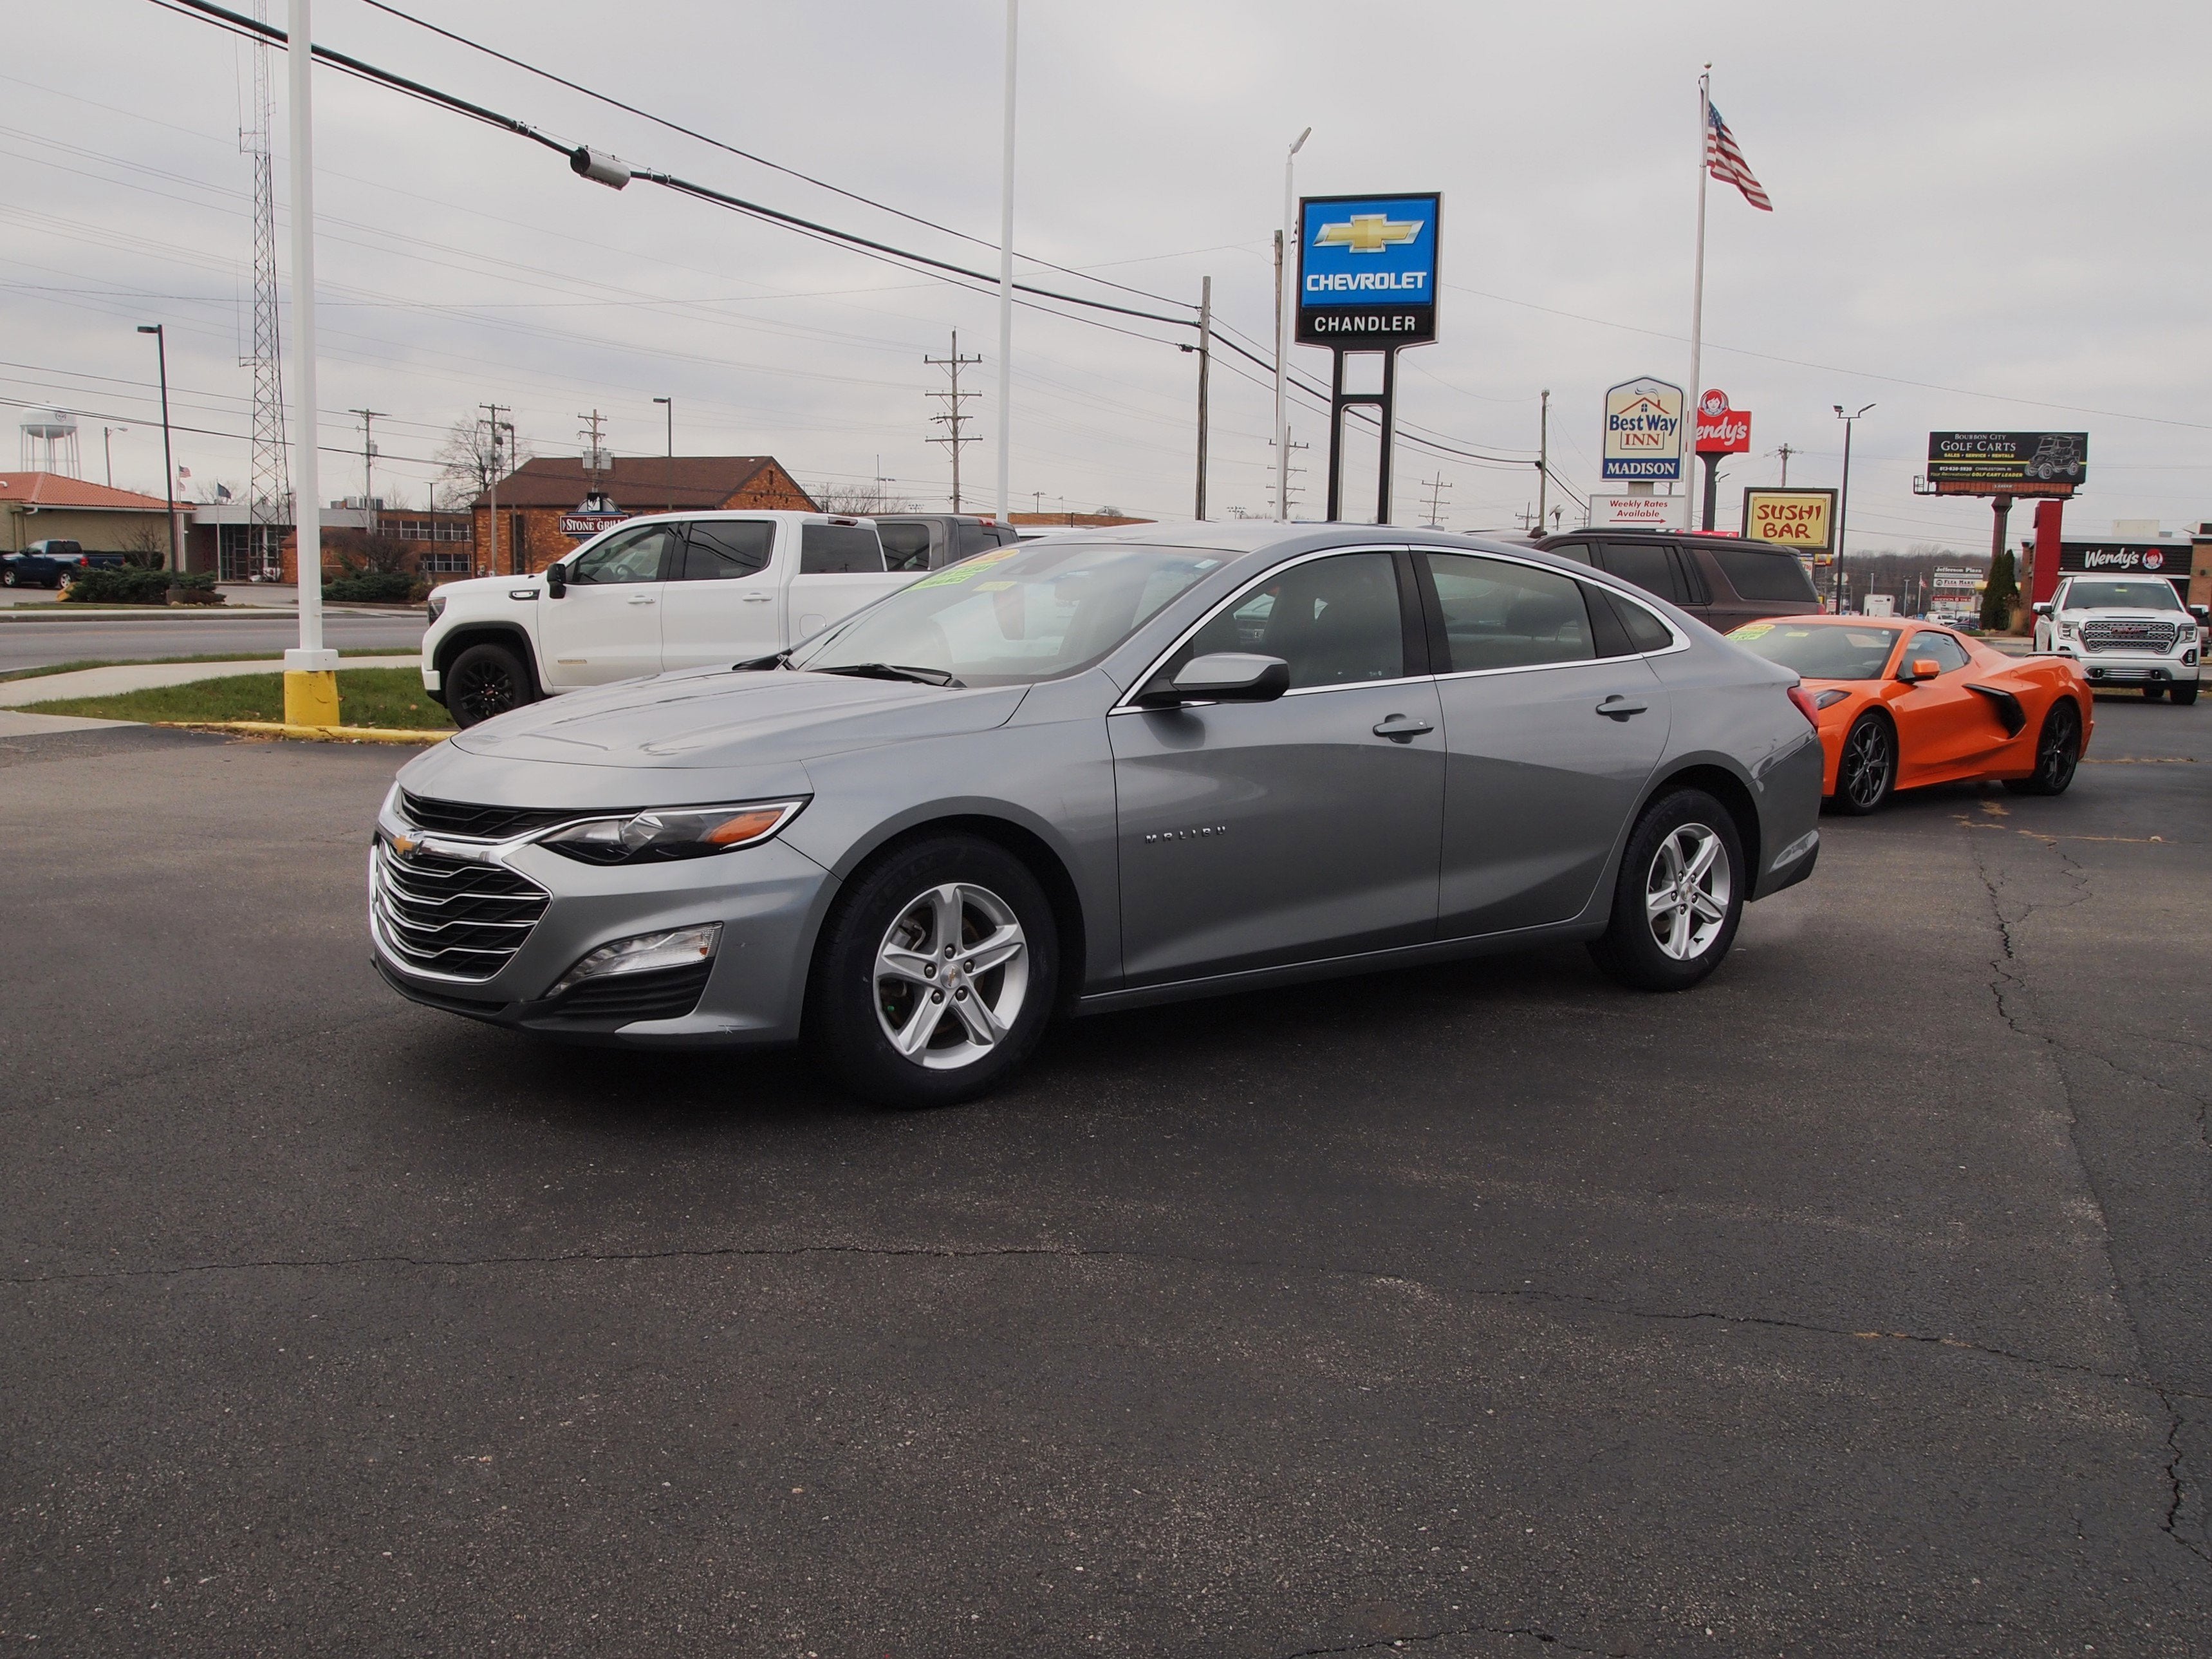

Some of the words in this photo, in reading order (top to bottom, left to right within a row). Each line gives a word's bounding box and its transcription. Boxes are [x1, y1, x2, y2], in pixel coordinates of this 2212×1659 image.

[1306, 272, 1427, 291] CHEVROLET
[1314, 316, 1416, 332] CHANDLER
[1610, 415, 1643, 431] Best
[1646, 415, 1678, 436] Way
[1695, 417, 1748, 446] endy's
[1624, 434, 1660, 445] INN
[1940, 440, 1973, 451] GOLF
[1976, 441, 2016, 451] CARTS
[1606, 463, 1675, 475] MADISON
[1610, 500, 1641, 509] Weekly
[1757, 504, 1821, 521] SUSHI
[566, 518, 595, 531] STONE
[597, 520, 621, 531] GRI
[1763, 522, 1811, 539] BAR
[2085, 547, 2139, 569] Wendy's
